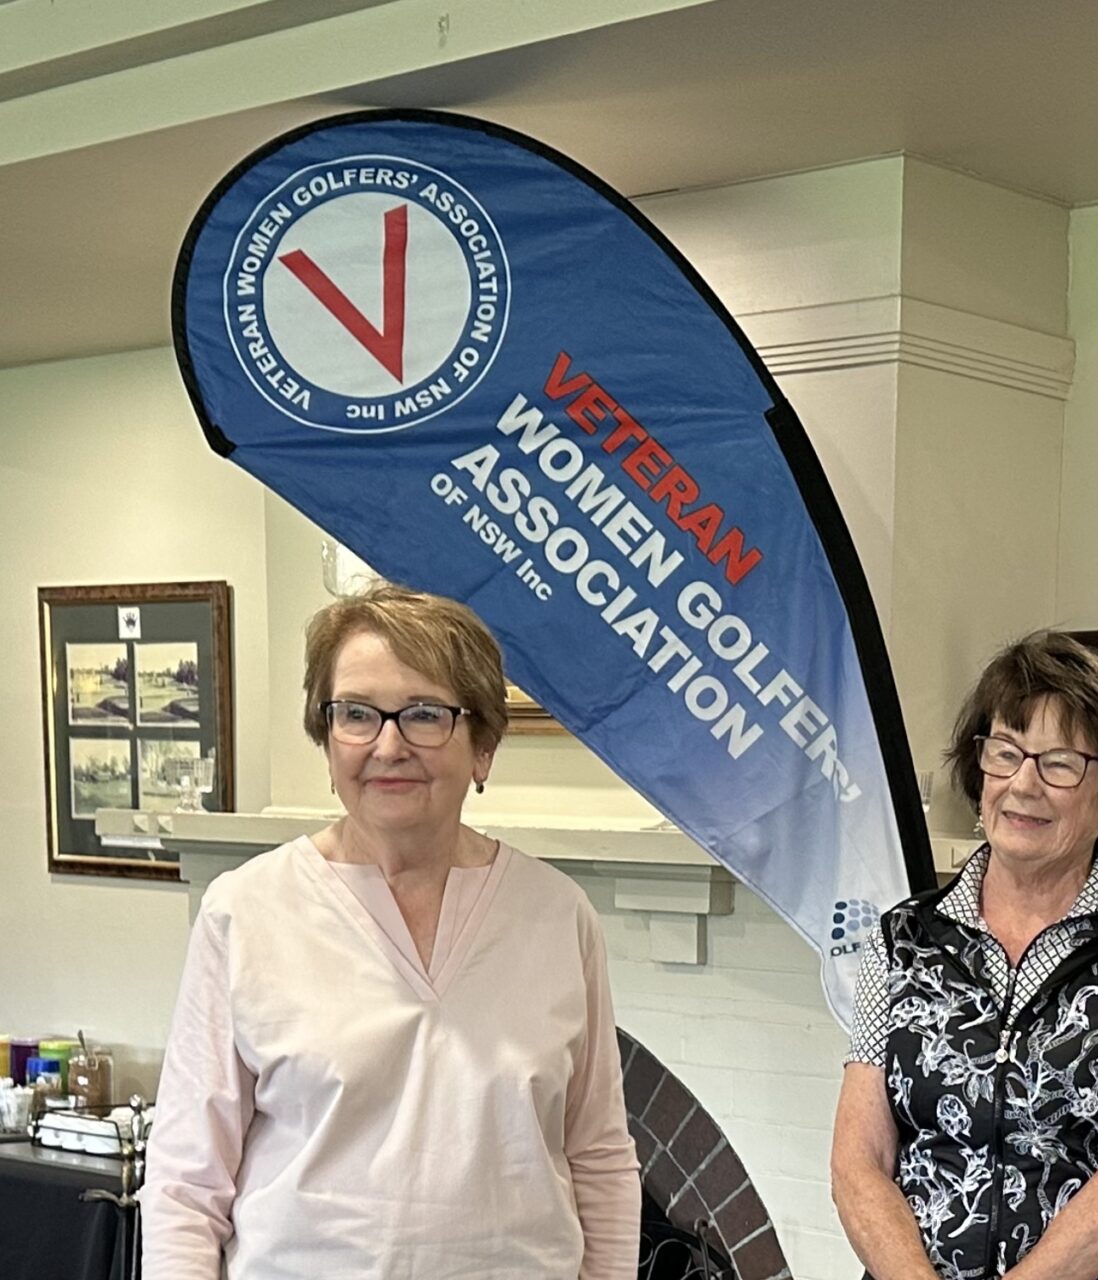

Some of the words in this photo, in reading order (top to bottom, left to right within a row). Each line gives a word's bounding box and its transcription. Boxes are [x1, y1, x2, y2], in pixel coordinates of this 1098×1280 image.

[292, 168, 418, 206] GOLFERS'
[237, 202, 292, 295] WOMEN
[277, 204, 408, 385] V
[419, 182, 498, 343] ASSOCIATION
[237, 304, 311, 410] VETERAN
[394, 377, 452, 417] NSW
[453, 347, 480, 383] OF
[346, 404, 385, 420] Inc
[496, 392, 685, 588] WOMEN
[543, 351, 763, 587] VETERAN
[430, 473, 469, 506] OF
[462, 504, 523, 564] NSW
[515, 559, 553, 601] Inc
[450, 443, 764, 761] ASSOCIATION
[830, 942, 861, 957] OLF
